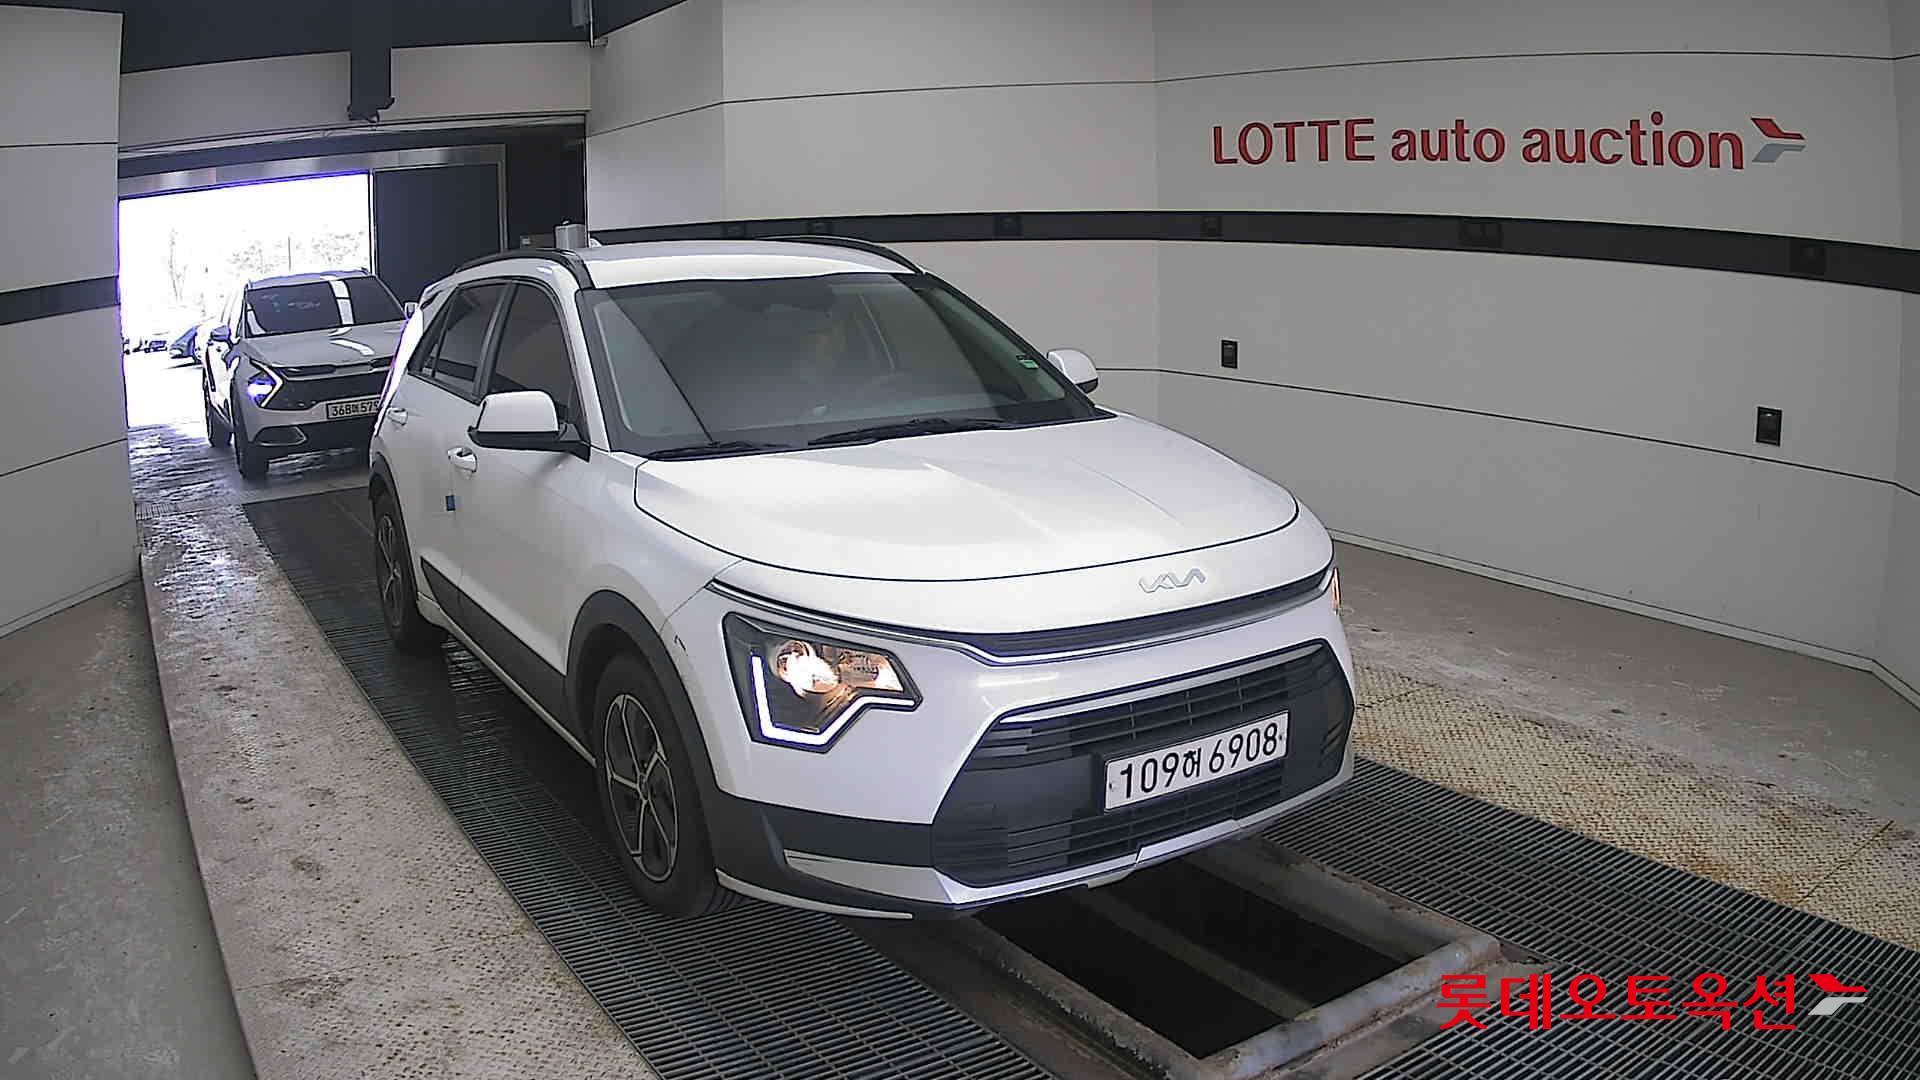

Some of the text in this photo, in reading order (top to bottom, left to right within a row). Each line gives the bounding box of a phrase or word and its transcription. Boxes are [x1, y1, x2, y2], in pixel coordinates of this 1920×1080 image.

[1212, 111, 1745, 171] LOTTE auto auction
